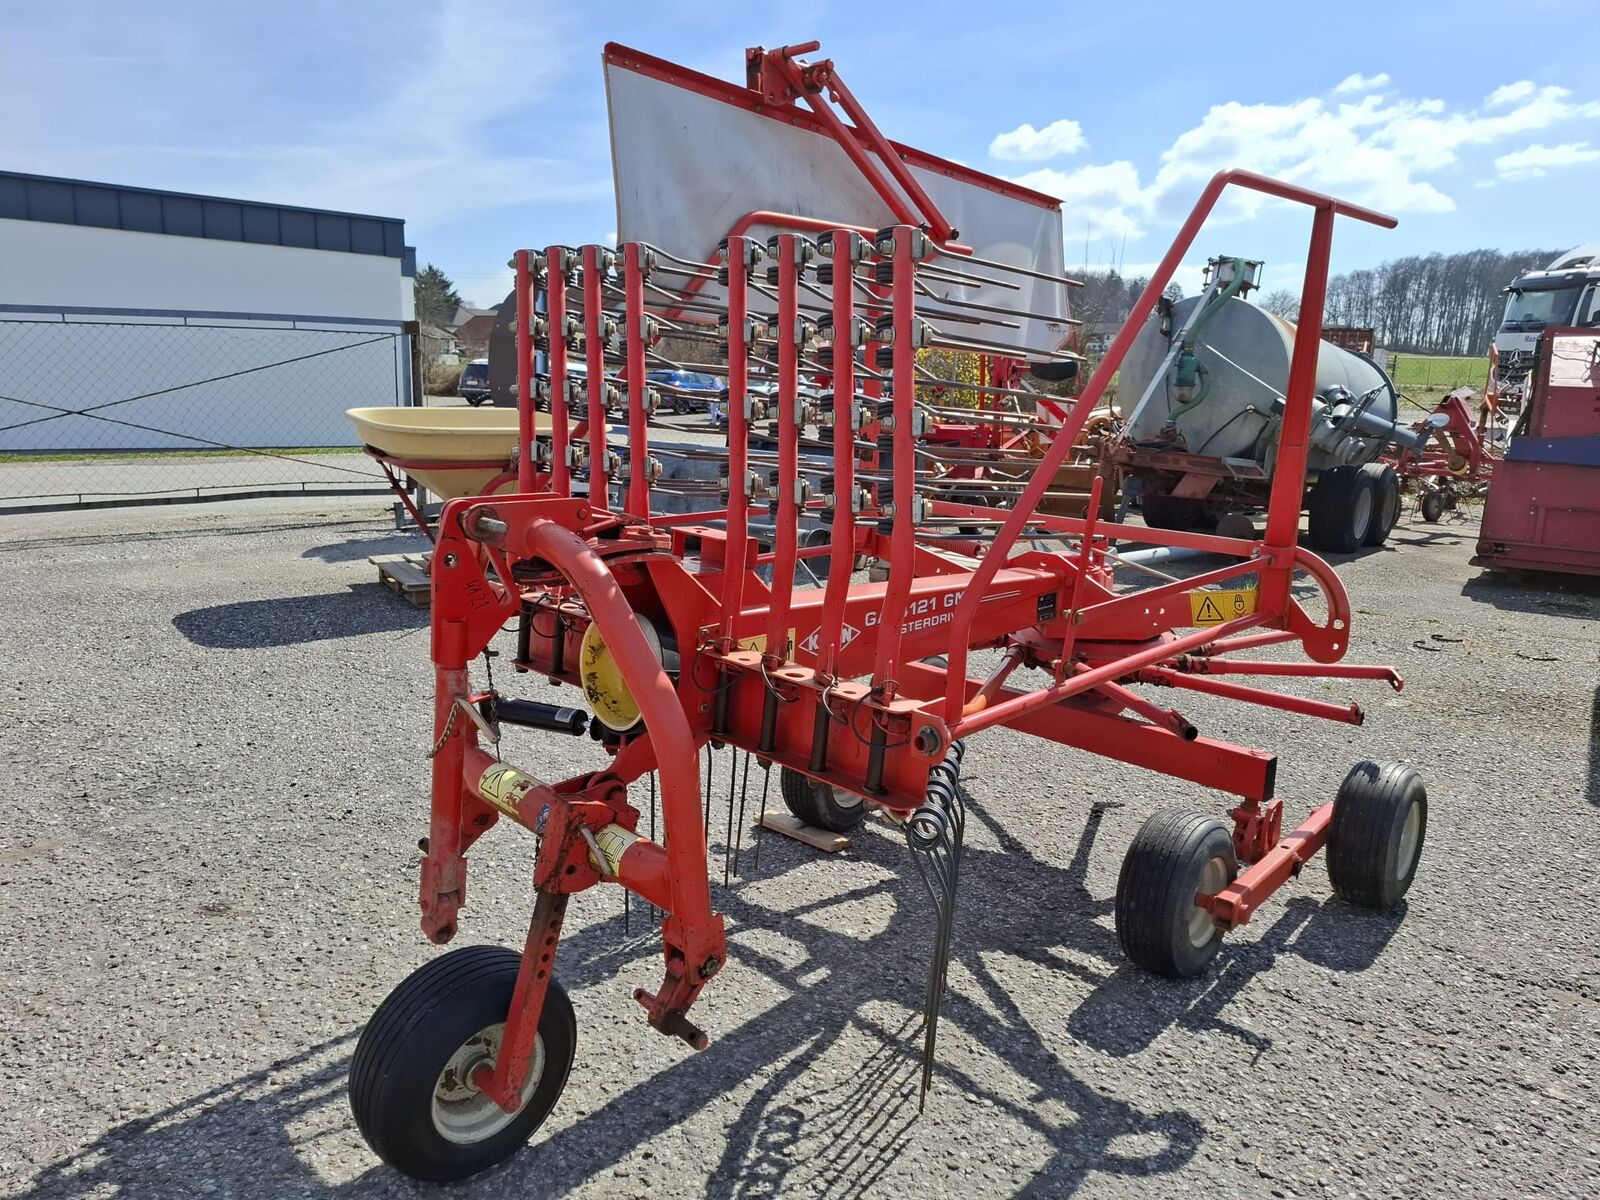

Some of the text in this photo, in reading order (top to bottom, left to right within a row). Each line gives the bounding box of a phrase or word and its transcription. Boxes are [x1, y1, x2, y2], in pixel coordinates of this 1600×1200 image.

[865, 611, 881, 627] G
[904, 597, 937, 617] 121
[901, 612, 954, 634] STERDRI
[808, 627, 852, 651] KN
